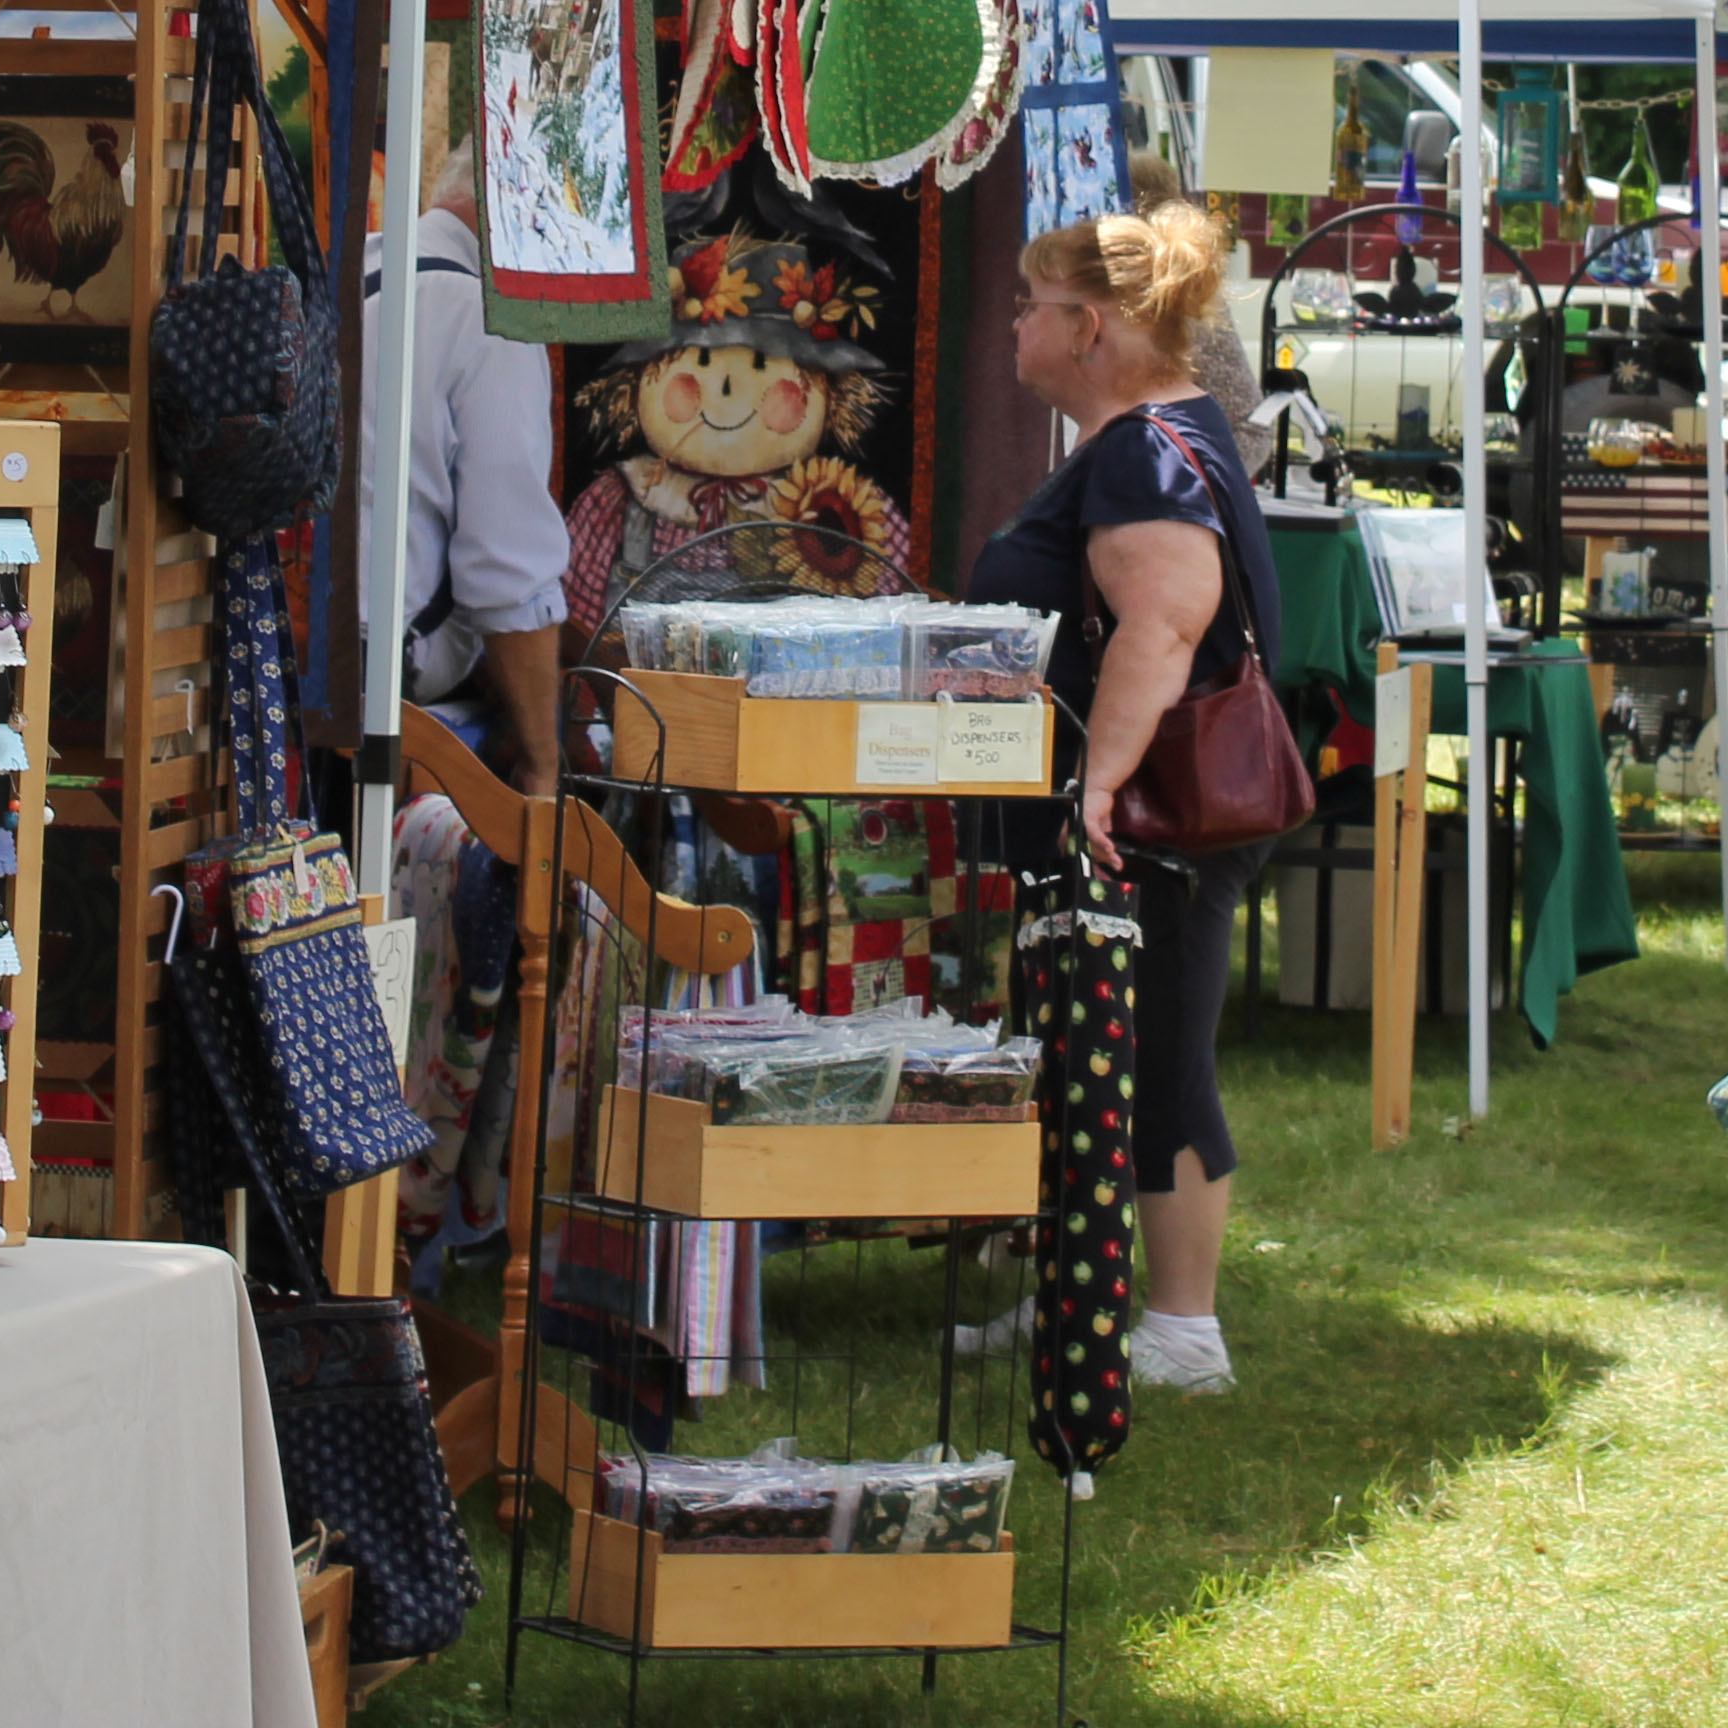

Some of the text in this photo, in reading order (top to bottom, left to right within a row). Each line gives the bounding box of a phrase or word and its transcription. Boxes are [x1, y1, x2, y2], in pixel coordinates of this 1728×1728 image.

[967, 712, 993, 728] BAG
[951, 730, 1023, 747] DISPENSERS
[867, 742, 931, 760] Dispensers
